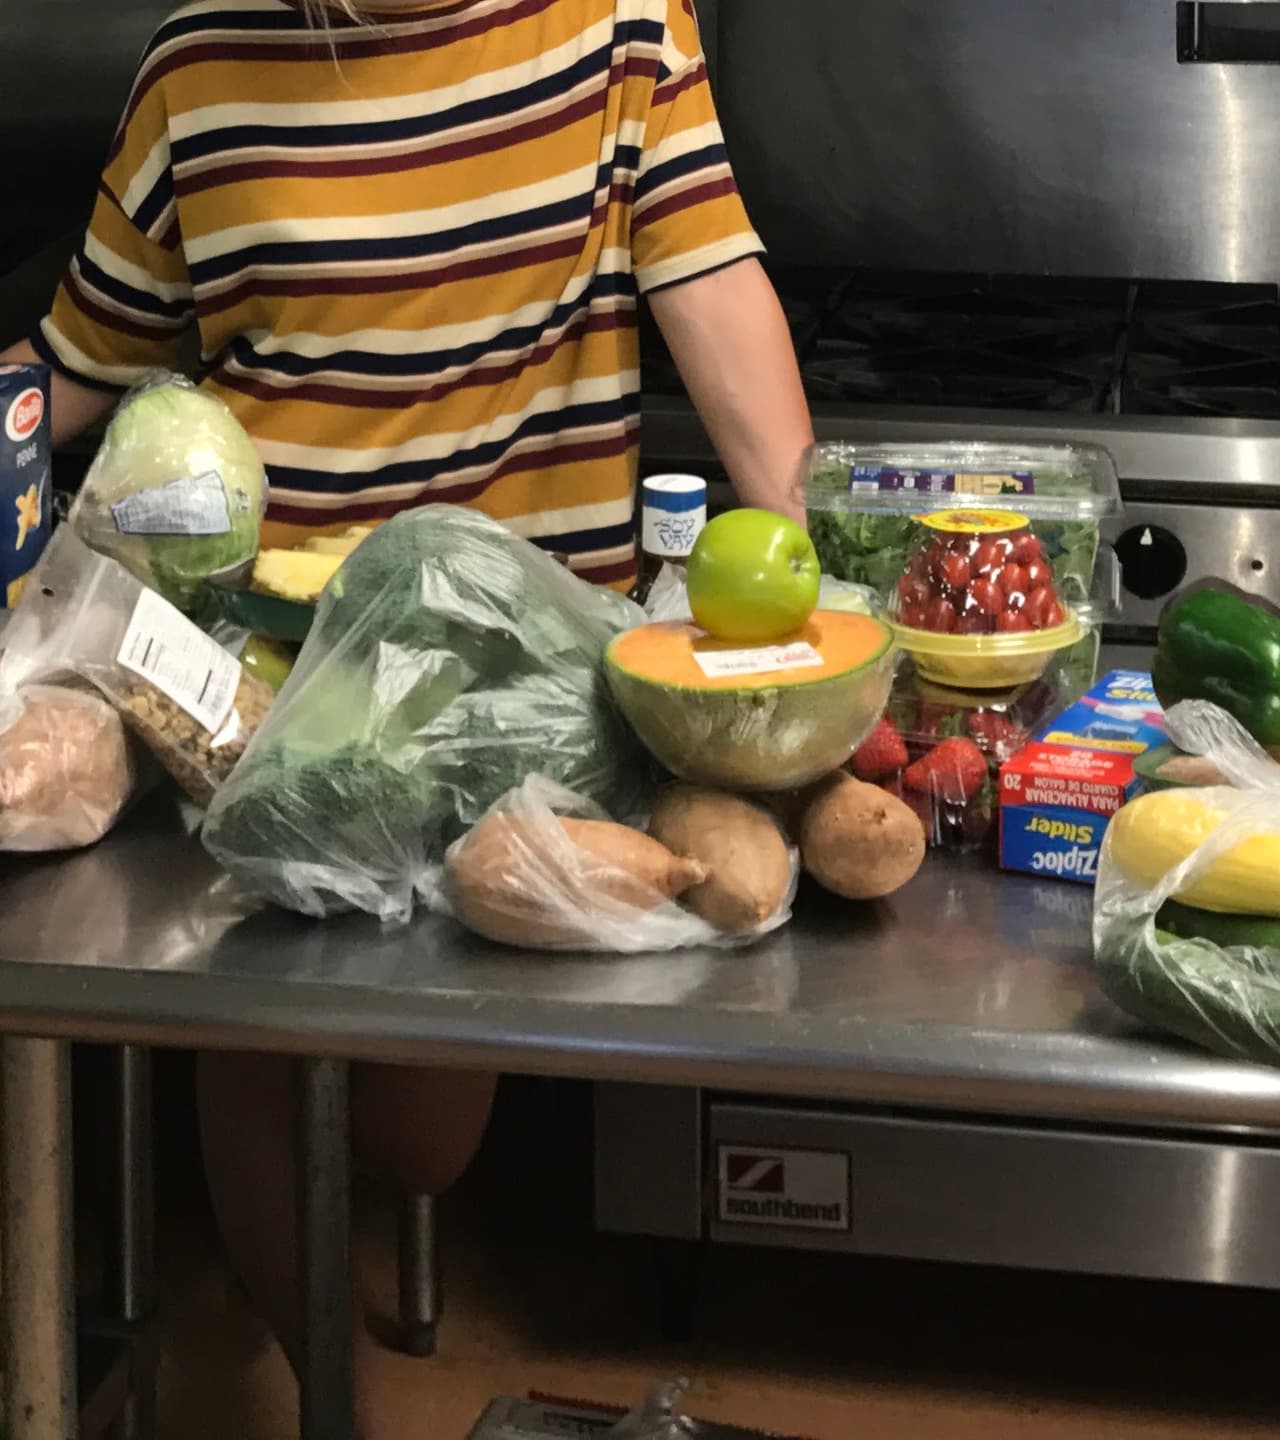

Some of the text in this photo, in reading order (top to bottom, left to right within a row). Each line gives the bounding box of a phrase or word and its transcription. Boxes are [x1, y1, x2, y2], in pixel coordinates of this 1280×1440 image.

[15, 442, 38, 469] PENNE
[653, 519, 696, 534] SOY
[660, 533, 695, 551] VAY
[1003, 773, 1021, 791] 20
[1067, 779, 1080, 792] DE
[1025, 787, 1120, 811] PARA ALMACENAR
[1024, 816, 1094, 844] Slider
[1031, 846, 1104, 876] Ziploc
[726, 1198, 842, 1222] southbend
